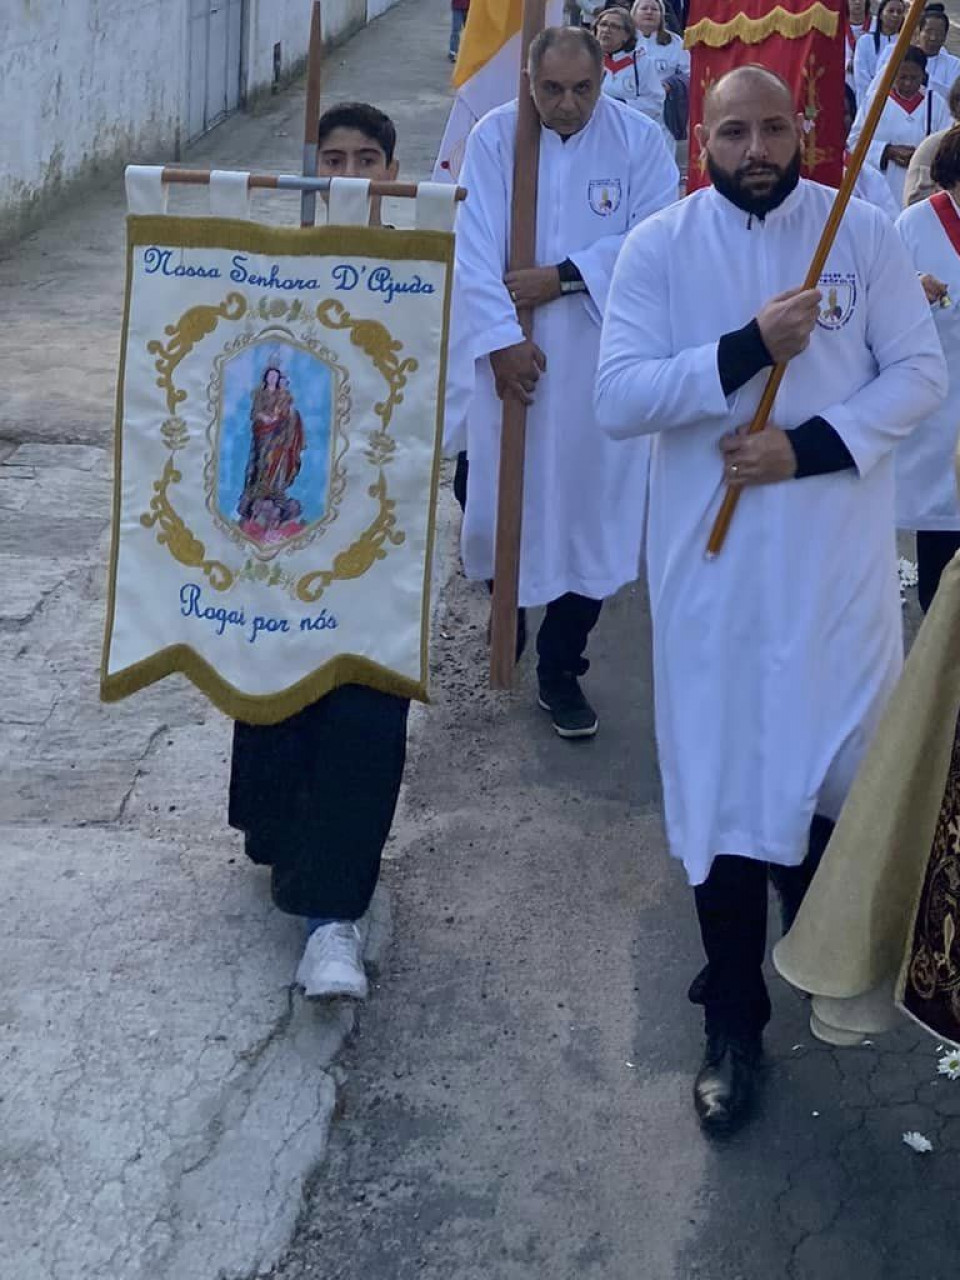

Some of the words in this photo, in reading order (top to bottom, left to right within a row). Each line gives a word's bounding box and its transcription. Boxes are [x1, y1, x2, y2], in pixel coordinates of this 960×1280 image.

[143, 247, 221, 278] Nossa
[229, 255, 321, 290] Senhora
[331, 264, 435, 303] D'Ajuda
[179, 583, 246, 636] Rogai
[249, 614, 291, 644] por
[299, 607, 339, 631] nós
